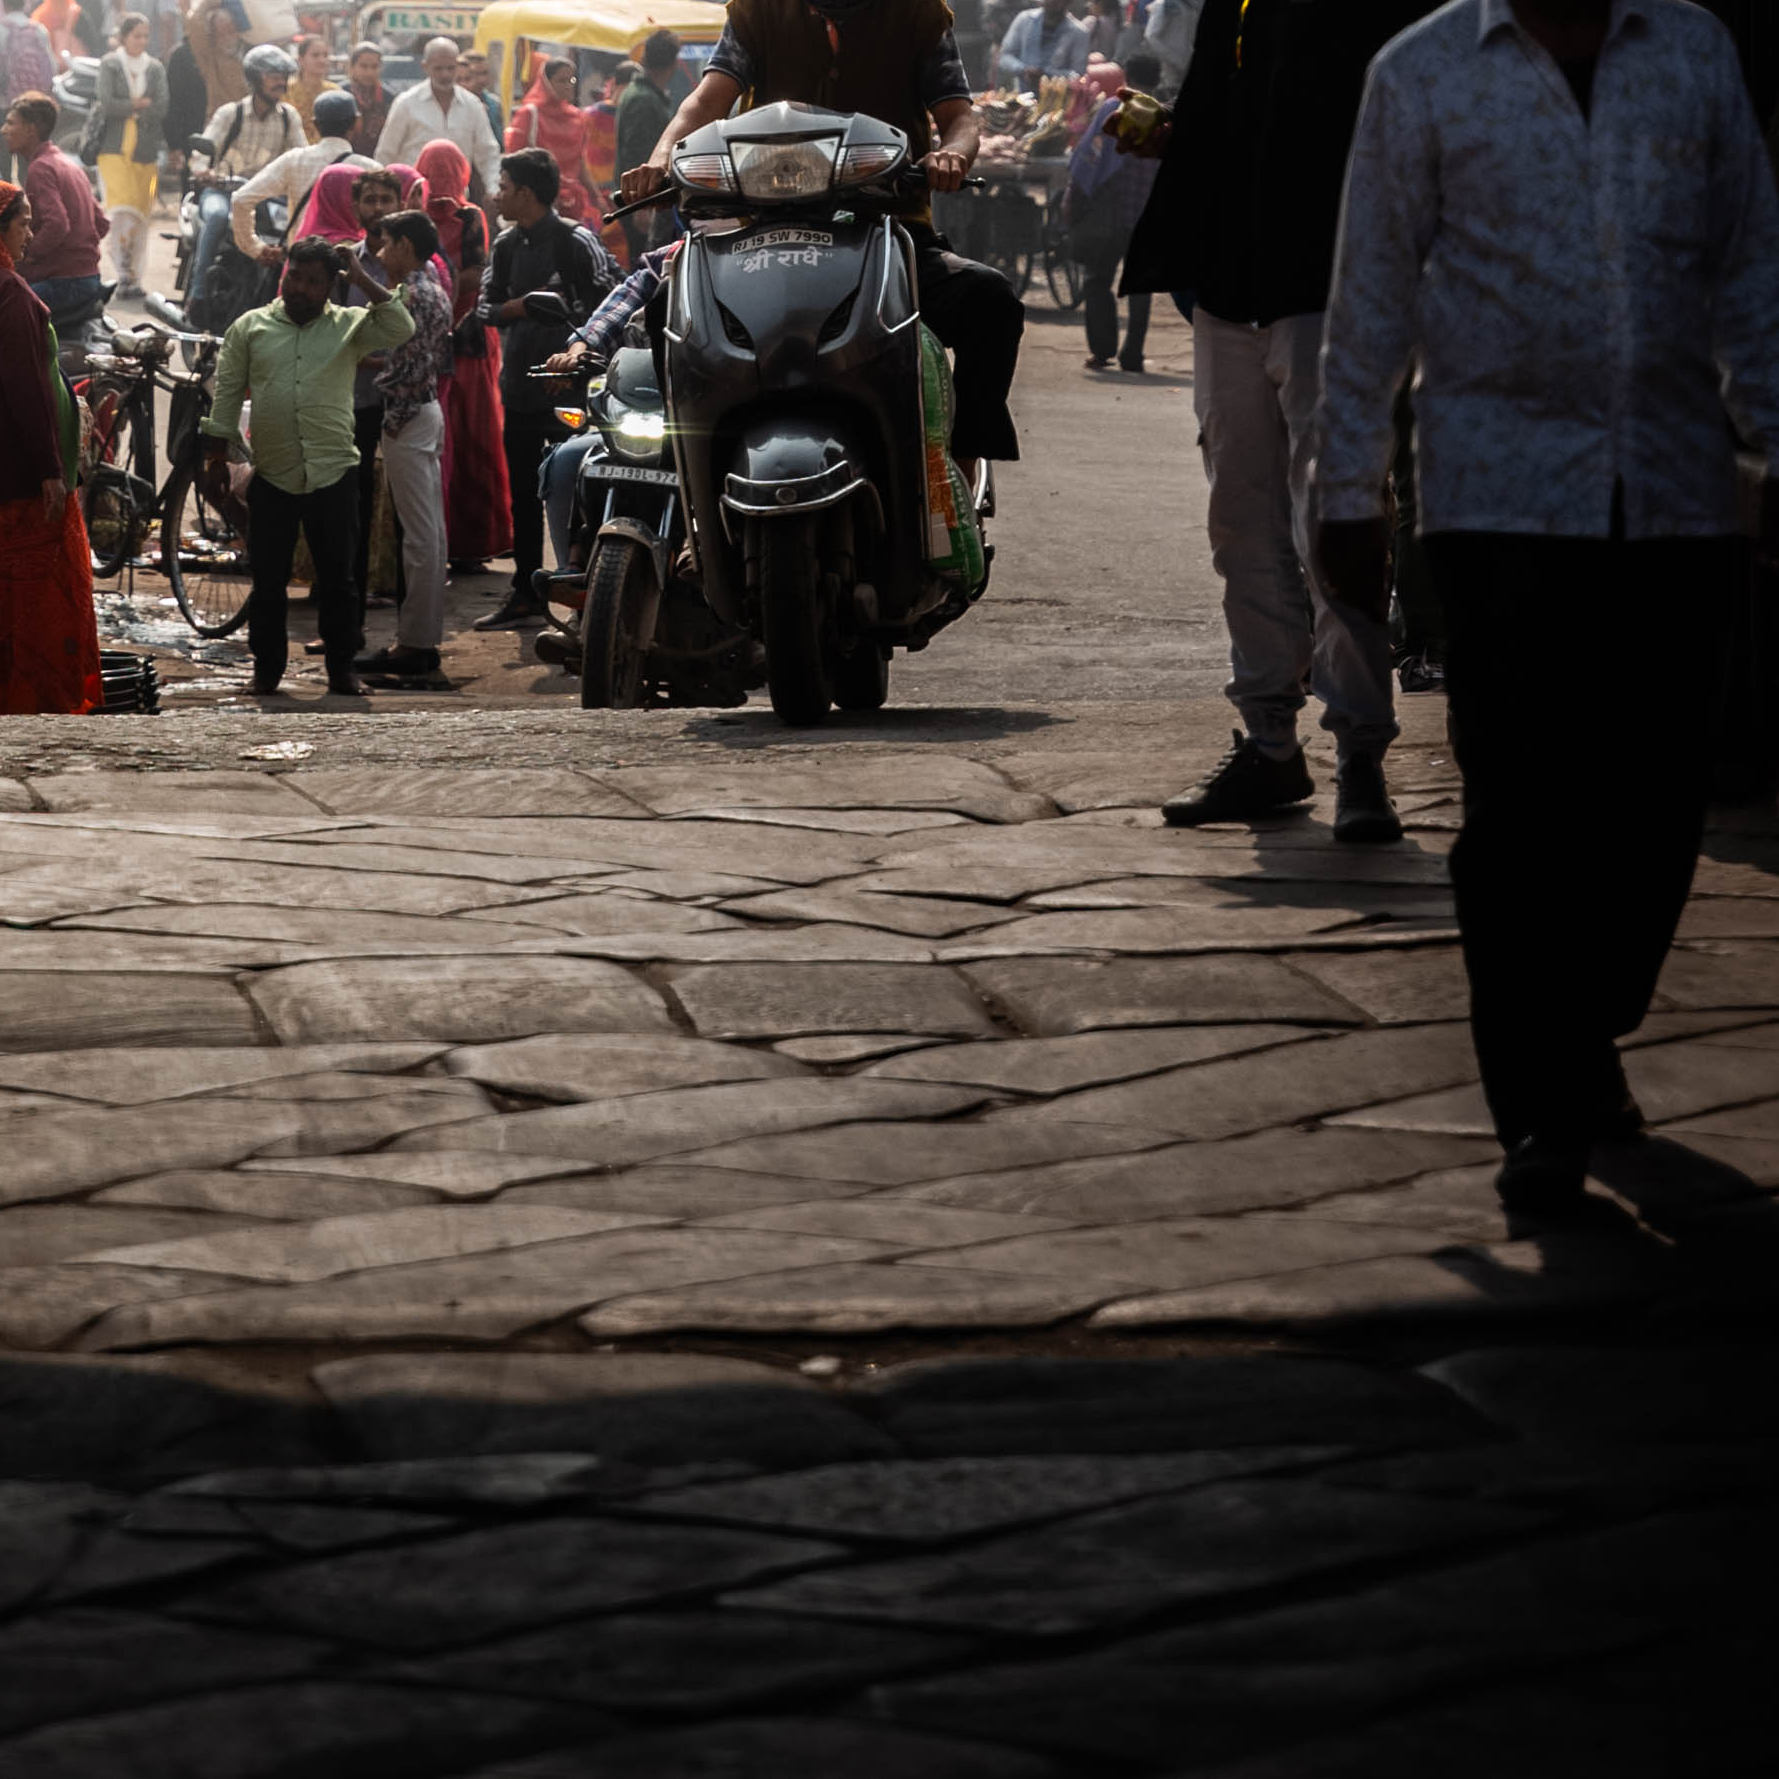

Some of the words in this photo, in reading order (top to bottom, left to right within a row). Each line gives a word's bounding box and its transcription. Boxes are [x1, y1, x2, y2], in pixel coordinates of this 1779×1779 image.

[734, 240, 748, 252] RJ
[752, 236, 764, 247] 19
[769, 230, 791, 242] SW
[795, 231, 831, 243] 7990
